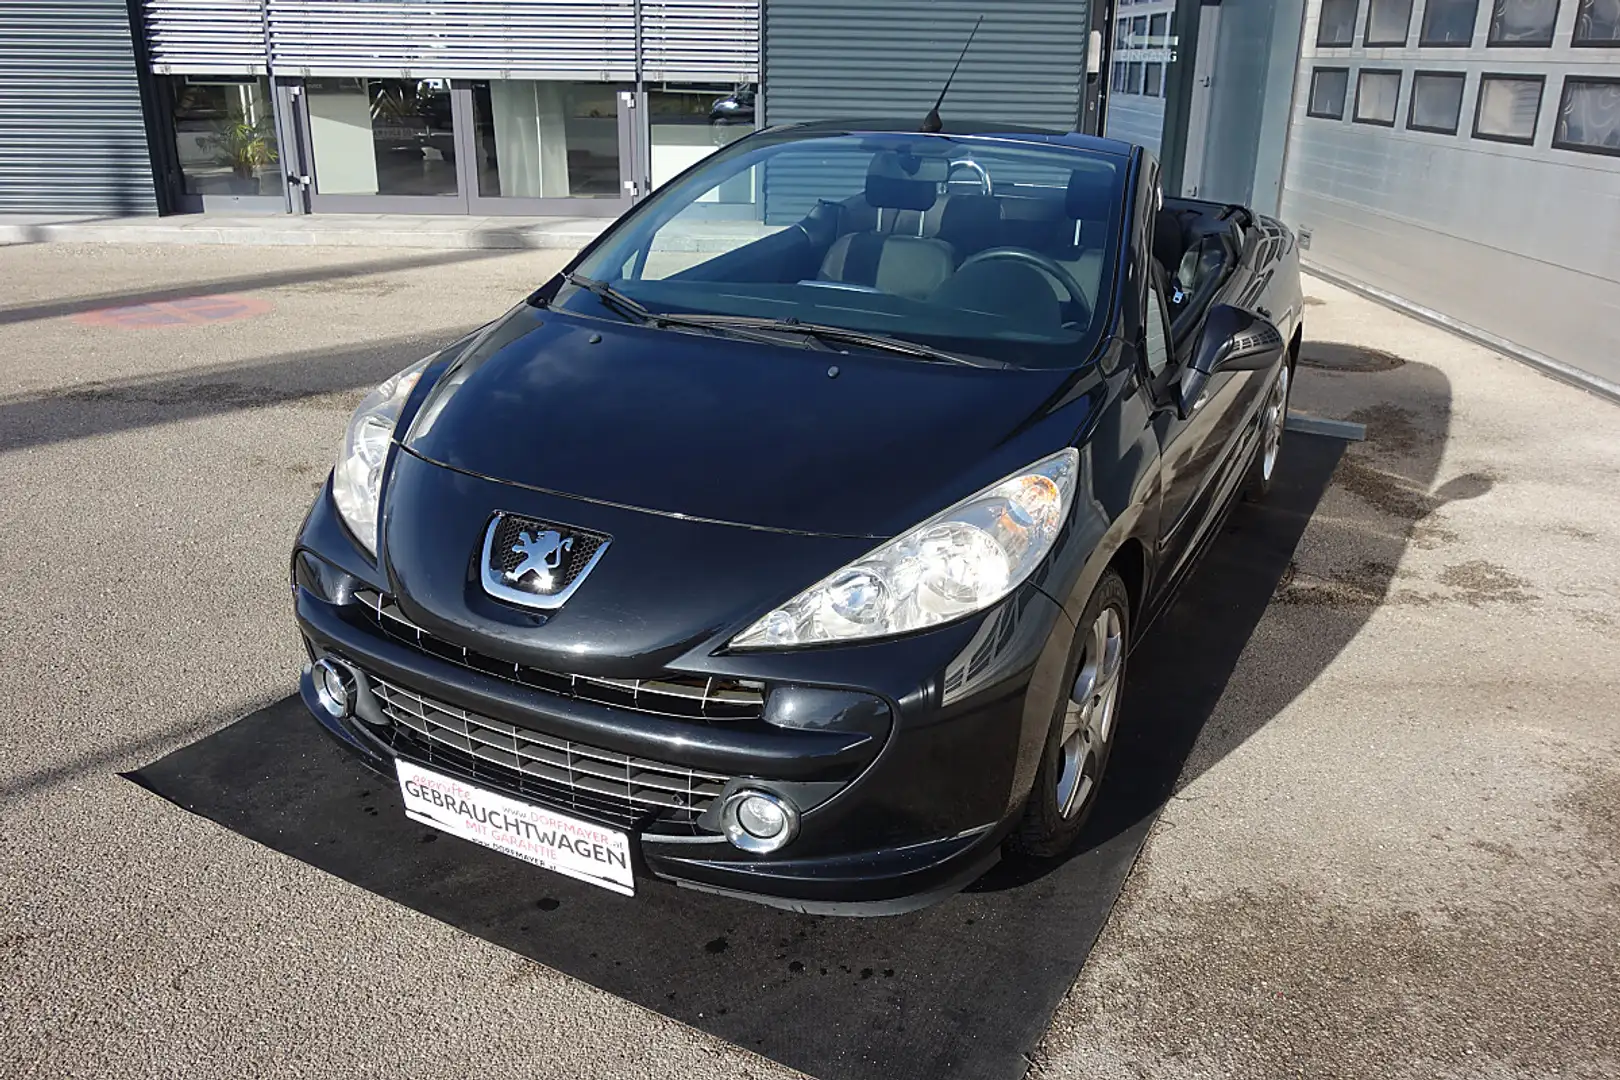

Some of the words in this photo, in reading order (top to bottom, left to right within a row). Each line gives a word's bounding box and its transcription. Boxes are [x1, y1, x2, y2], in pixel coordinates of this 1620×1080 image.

[405, 780, 627, 869] GEBRAUCHTWAGEN
[466, 819, 488, 835] MIT
[491, 830, 557, 860] GARANTIE
